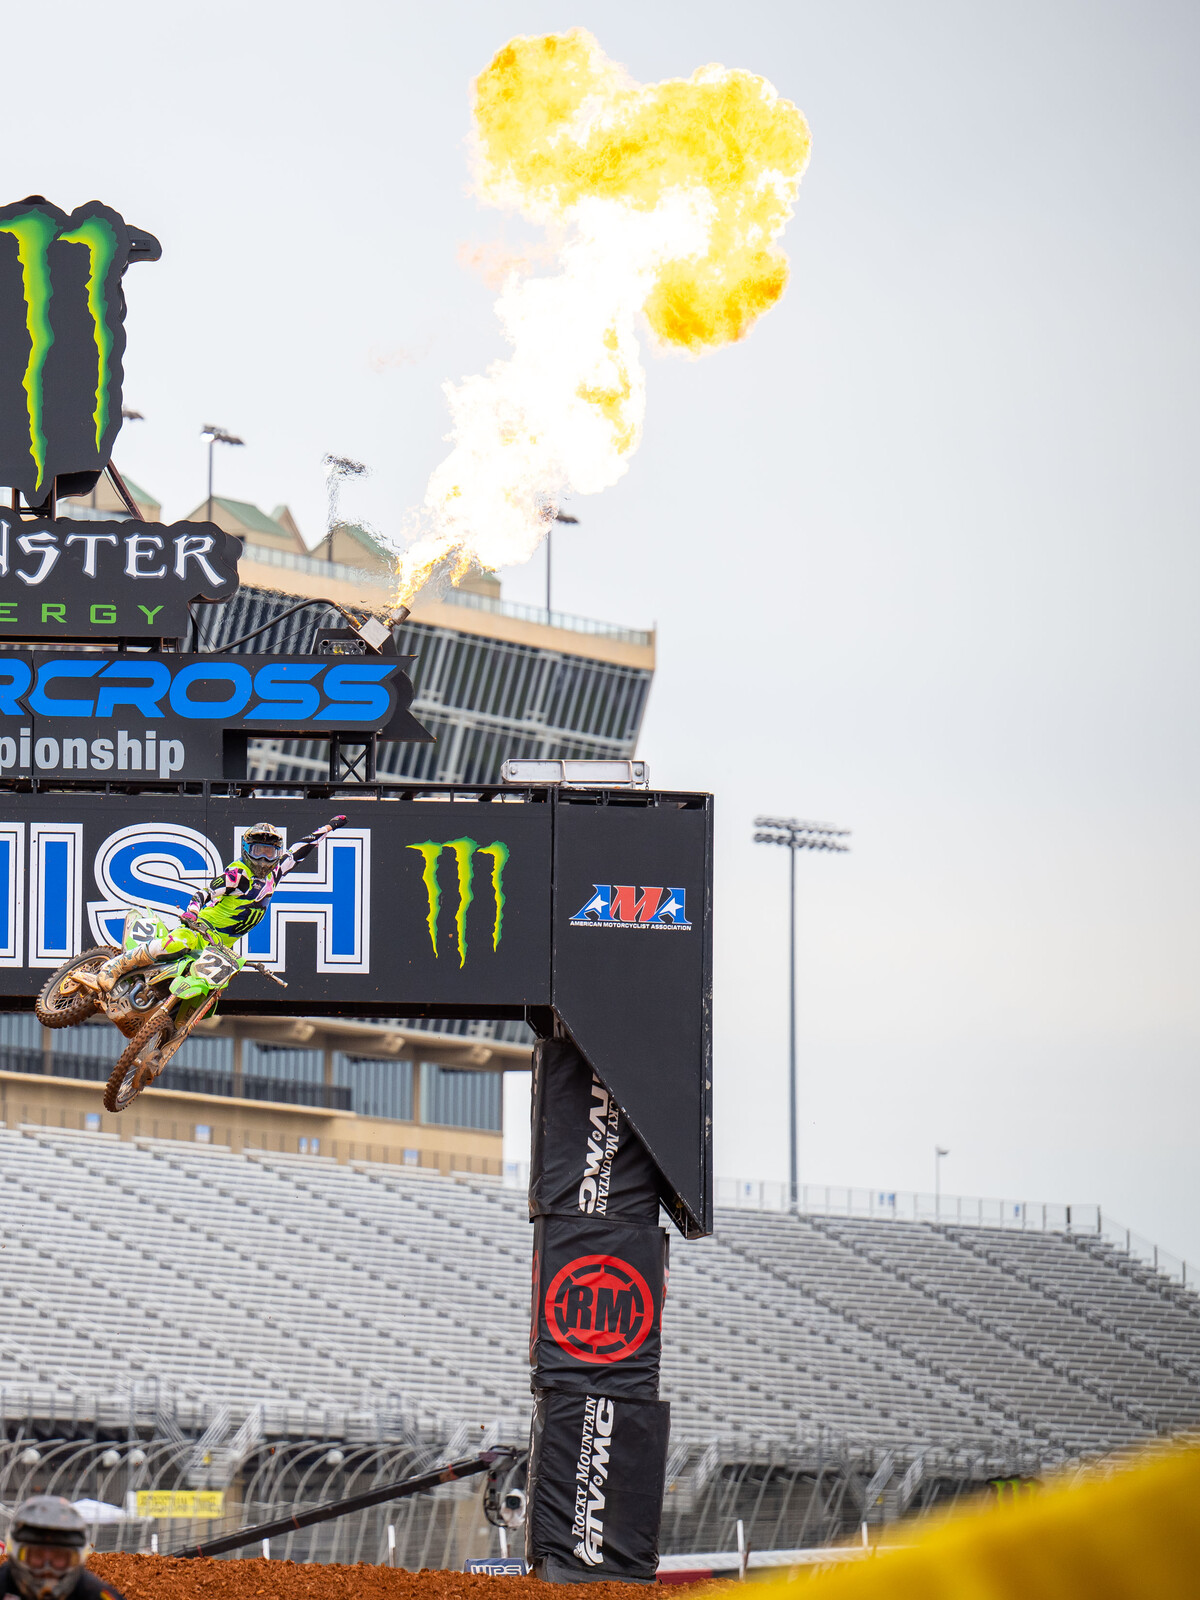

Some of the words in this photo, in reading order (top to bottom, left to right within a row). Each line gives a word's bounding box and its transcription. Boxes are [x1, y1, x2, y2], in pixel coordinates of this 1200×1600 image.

[569, 884, 692, 924] AMA
[132, 919, 155, 942] 21
[195, 954, 235, 984] 21
[595, 1131, 620, 1216] MOUNTAIN
[566, 1284, 633, 1335] RM
[576, 1395, 597, 1486] MOUNTAIN
[572, 1485, 588, 1539] ROCKY
